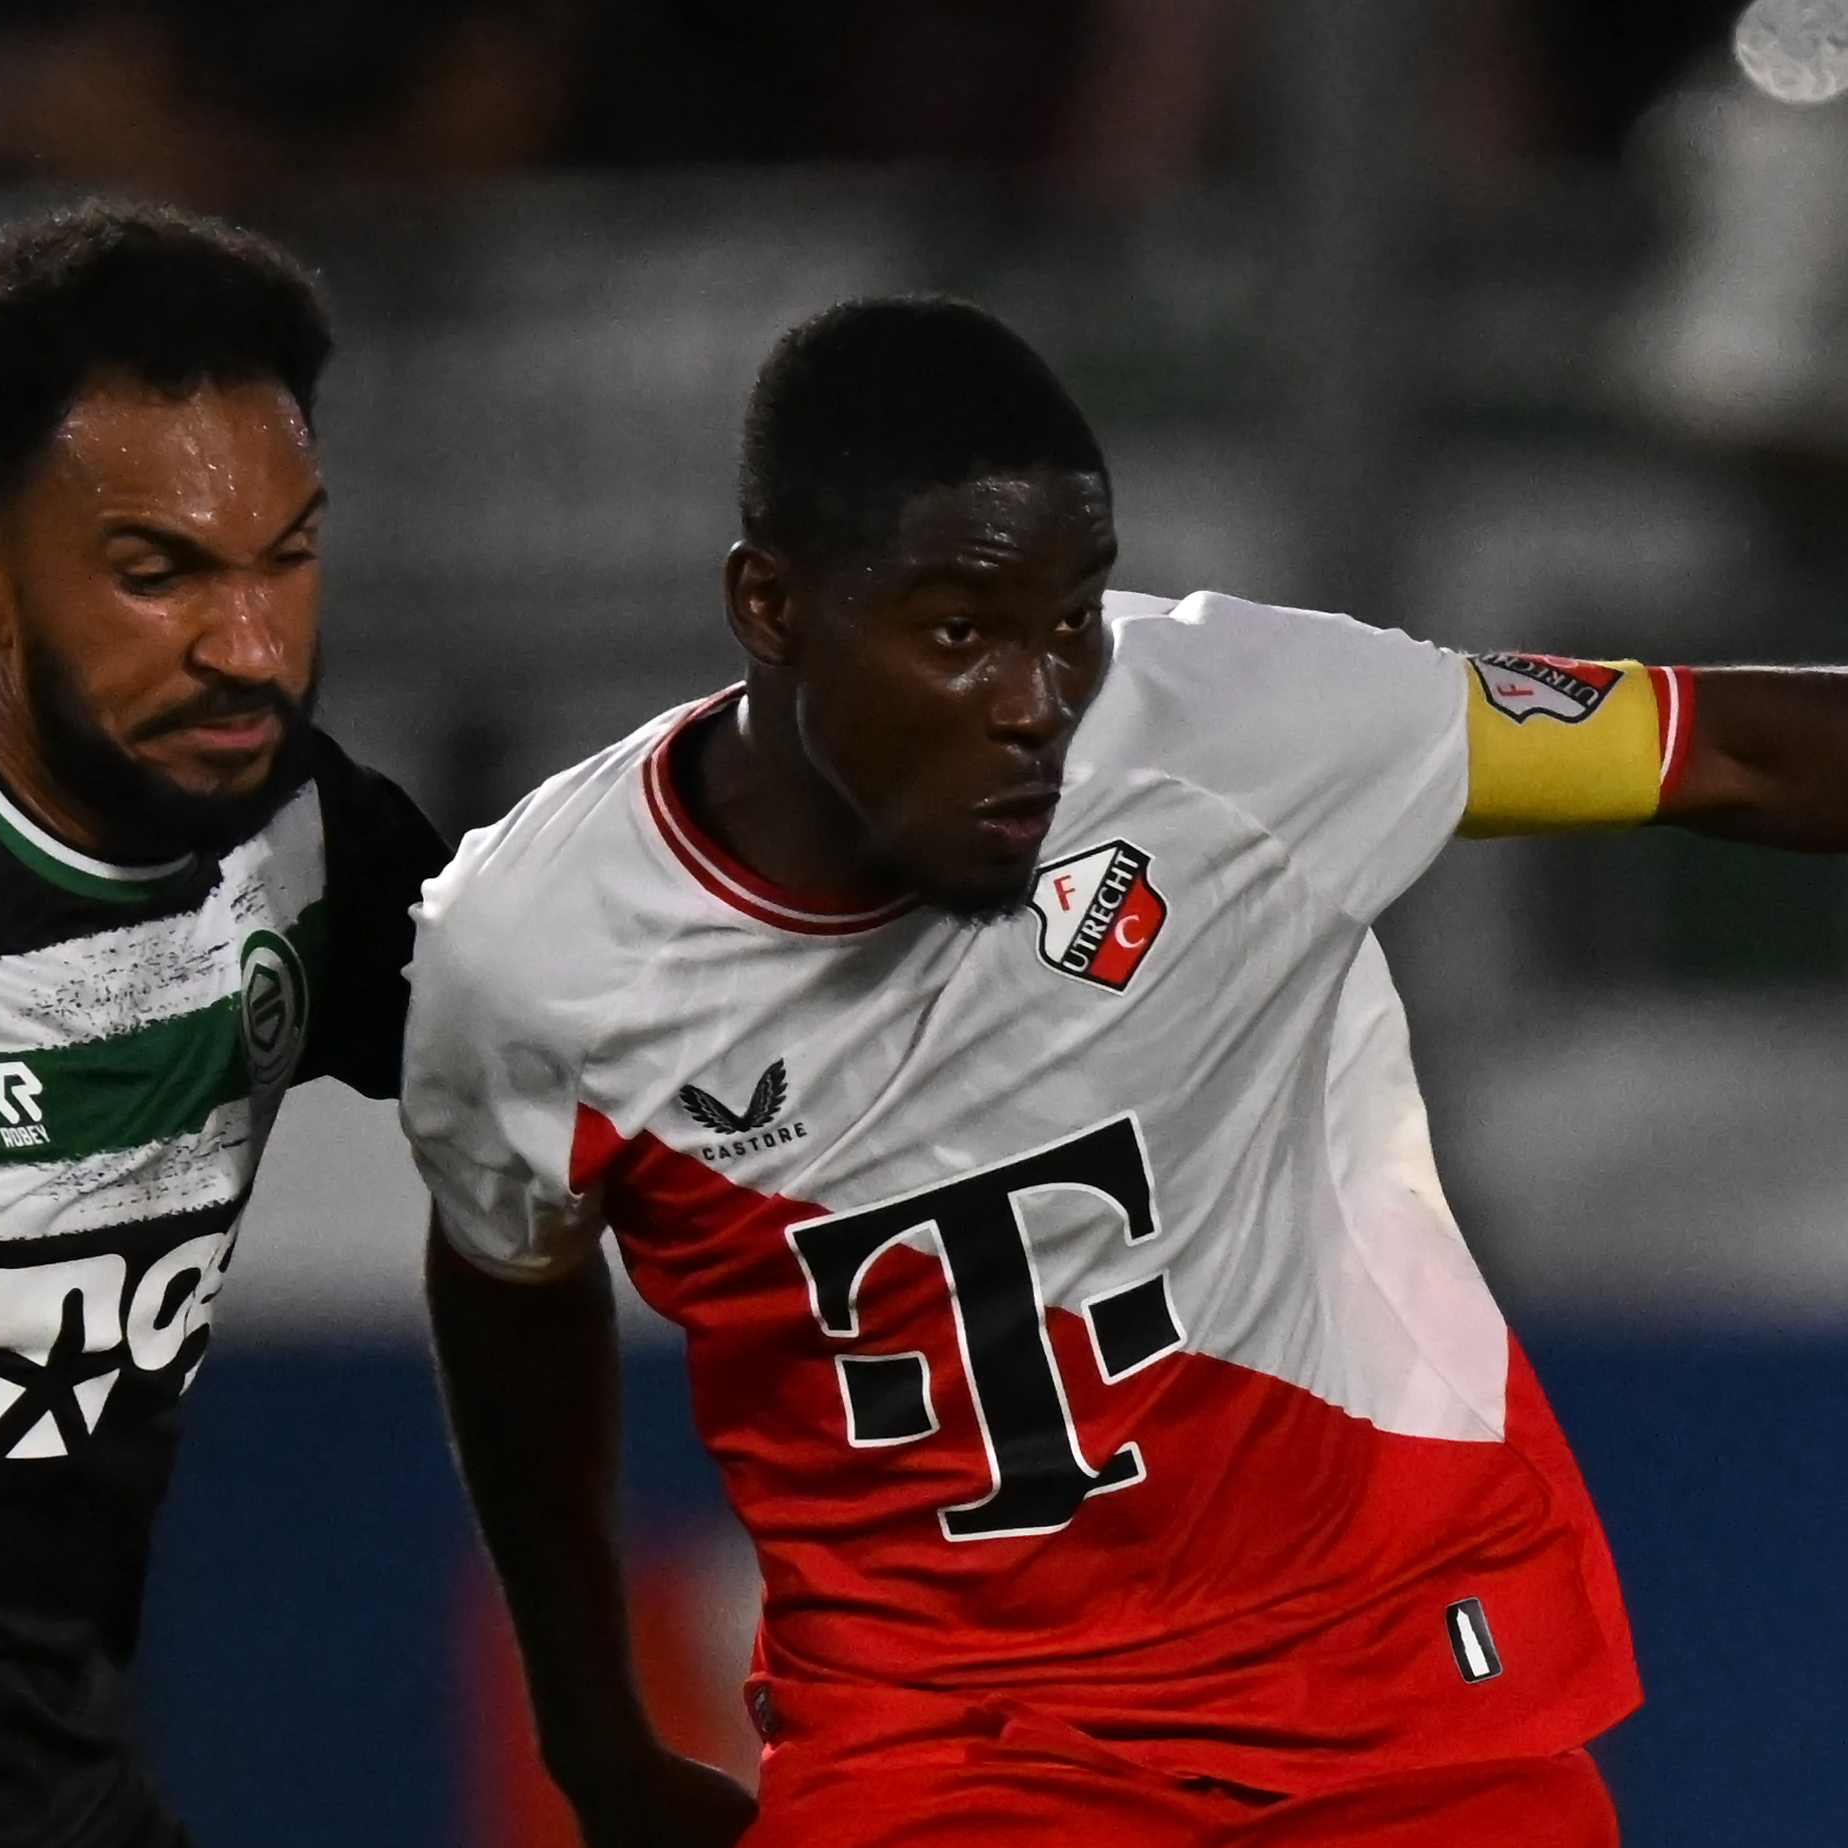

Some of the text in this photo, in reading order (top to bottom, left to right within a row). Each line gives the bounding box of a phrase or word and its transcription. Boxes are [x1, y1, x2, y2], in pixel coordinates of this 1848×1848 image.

[1053, 874, 1076, 911] F
[1062, 850, 1140, 973] UTRECHT
[1114, 914, 1146, 949] C
[702, 1121, 808, 1161] CASTORE
